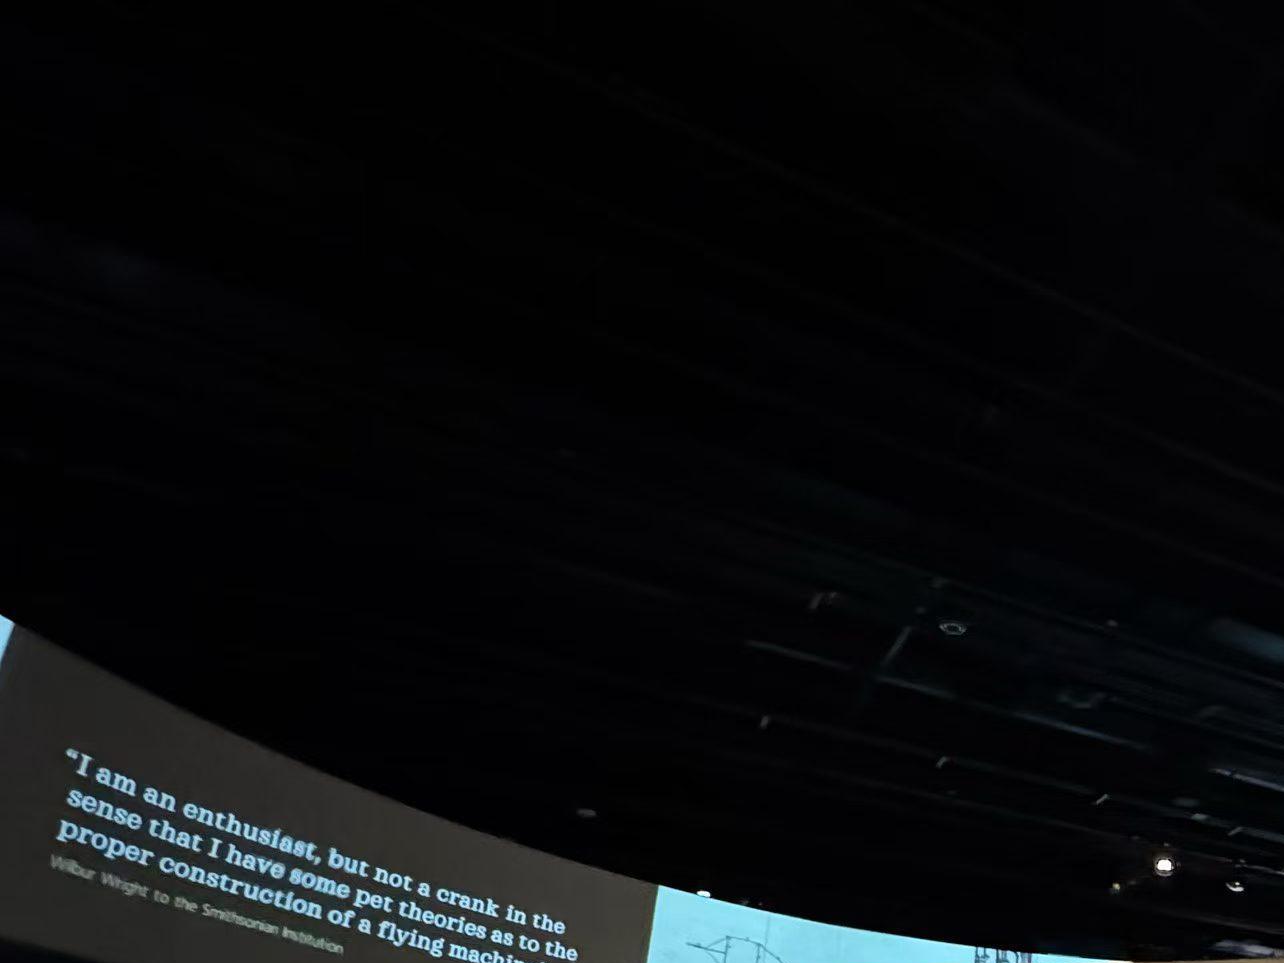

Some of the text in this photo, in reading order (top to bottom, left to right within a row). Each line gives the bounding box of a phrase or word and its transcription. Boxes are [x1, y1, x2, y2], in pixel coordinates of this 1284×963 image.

[50, 853, 344, 955] Wilbur Wright to the Smithsonian Institution
[56, 819, 155, 866] proper
[159, 857, 322, 920] construction
[327, 909, 356, 928] of
[358, 918, 372, 935] a
[377, 920, 445, 958] flying
[66, 789, 578, 962] sense that I have some pet theories as to the
[95, 767, 137, 797] am
[143, 787, 176, 812] an
[182, 803, 321, 865] enthusiast,
[328, 847, 370, 878] but
[373, 867, 413, 892] not
[417, 882, 431, 897] a
[436, 888, 500, 918] crank
[505, 905, 527, 925] in
[532, 913, 566, 935] the
